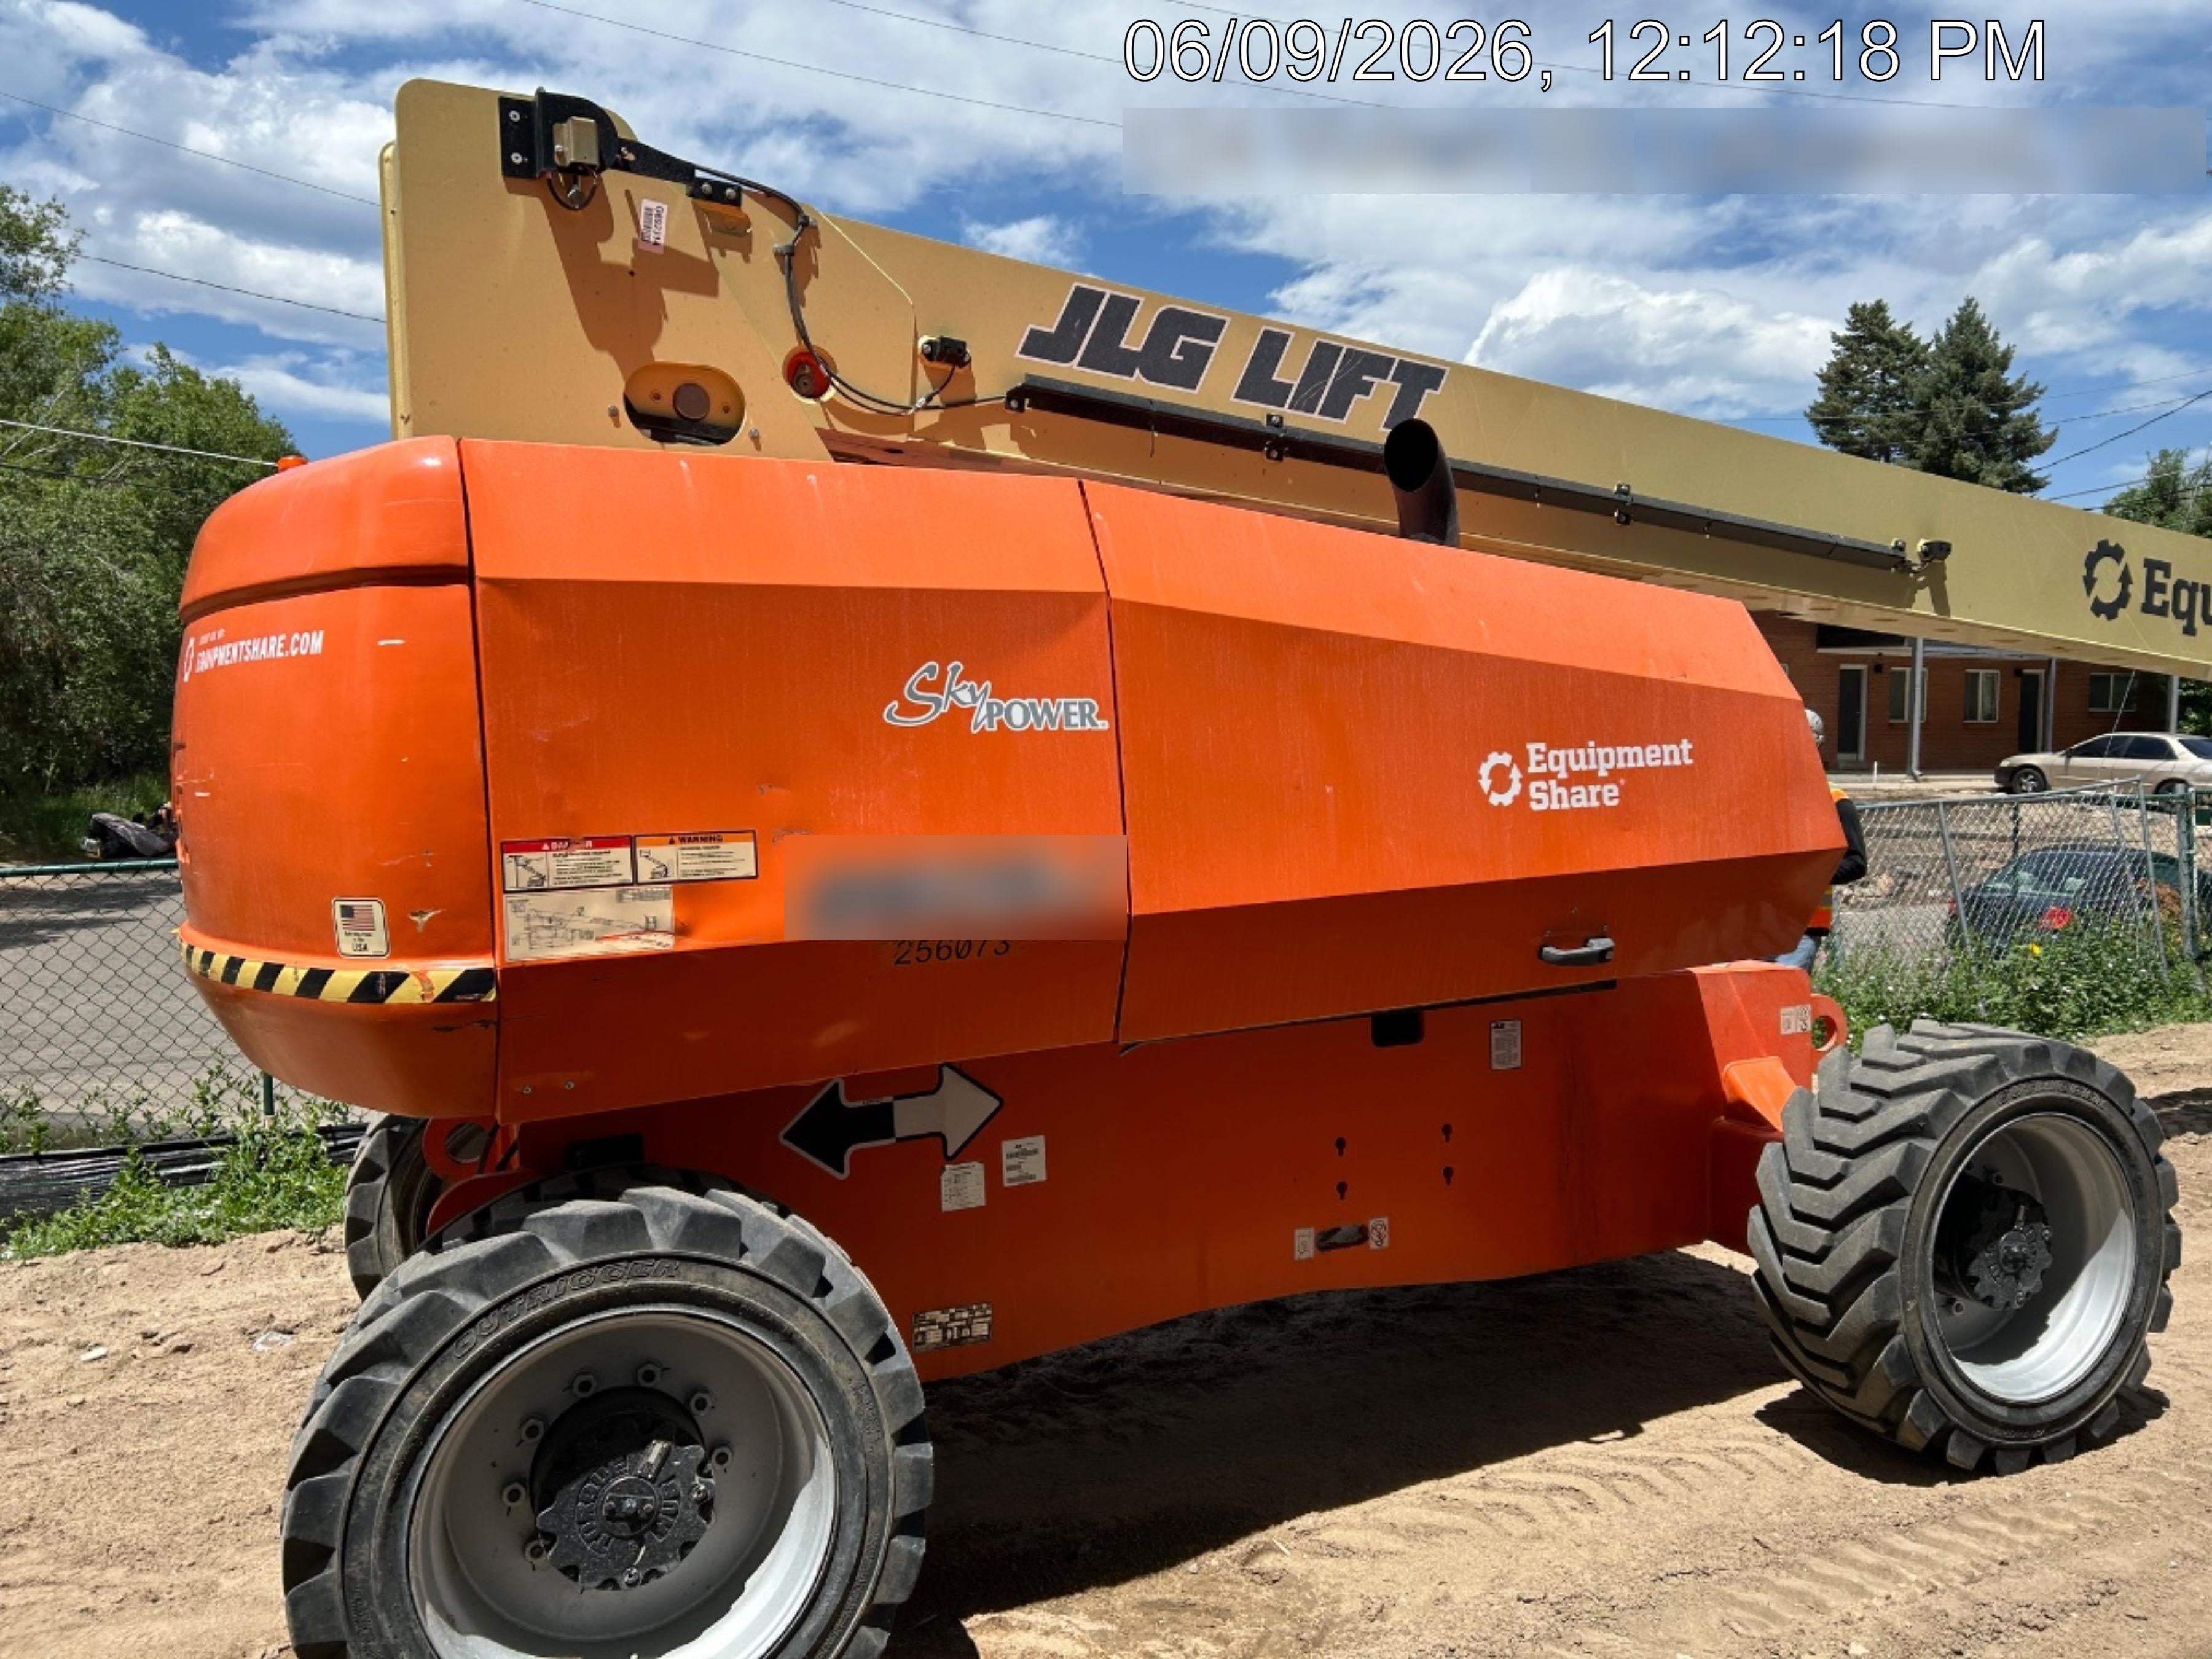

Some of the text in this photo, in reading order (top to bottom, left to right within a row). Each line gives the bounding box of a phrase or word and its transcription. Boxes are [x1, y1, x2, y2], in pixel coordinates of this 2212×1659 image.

[1014, 281, 1451, 431] JLG LIFT
[1526, 738, 1694, 779] Equipment
[1528, 779, 1620, 812] Share
[678, 834, 723, 844] WARNING
